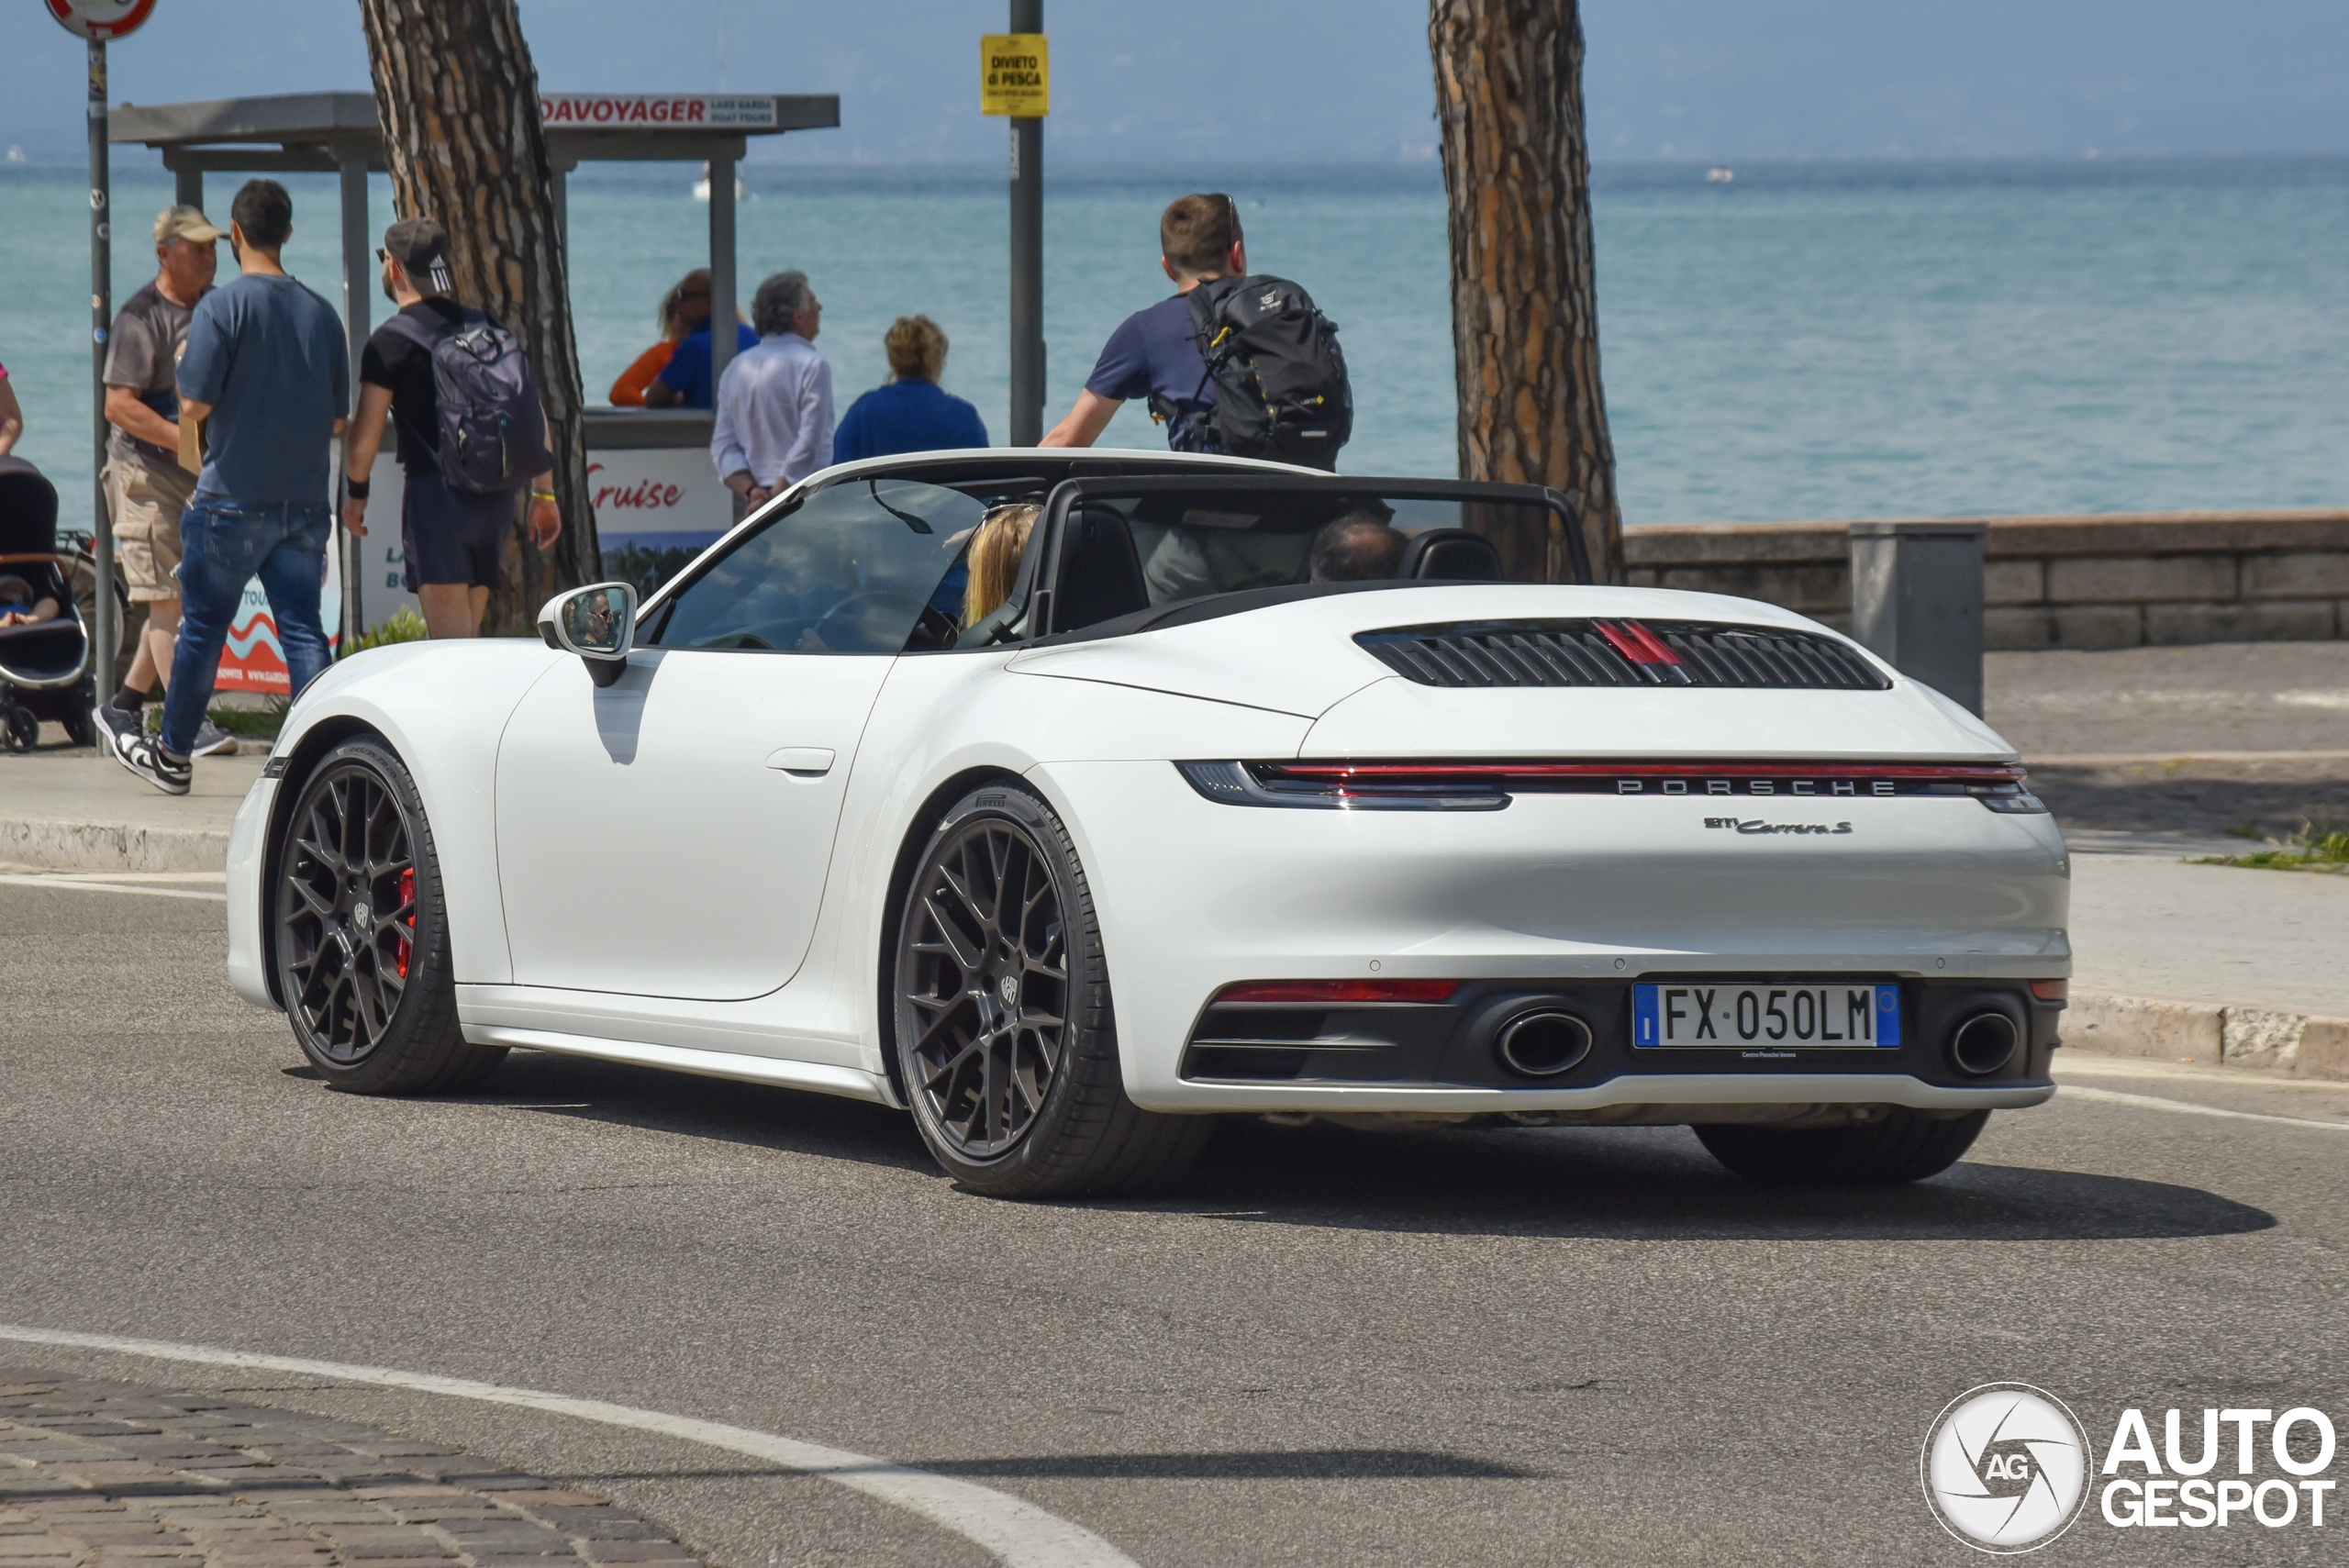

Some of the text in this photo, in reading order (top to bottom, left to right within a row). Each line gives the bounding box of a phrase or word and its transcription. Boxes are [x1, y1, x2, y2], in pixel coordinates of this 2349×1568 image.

[992, 56, 1038, 69] DIVIETO
[988, 72, 1041, 85] di PESCA
[738, 100, 771, 109] GARDA
[739, 112, 772, 123] TOURS
[1618, 780, 1895, 795] PORSCHE
[975, 794, 1007, 808] PIRELLI
[1736, 818, 1830, 835] Carrera
[1831, 820, 1854, 834] S
[1665, 988, 1718, 1040] FX
[1736, 988, 1872, 1040] 050LM
